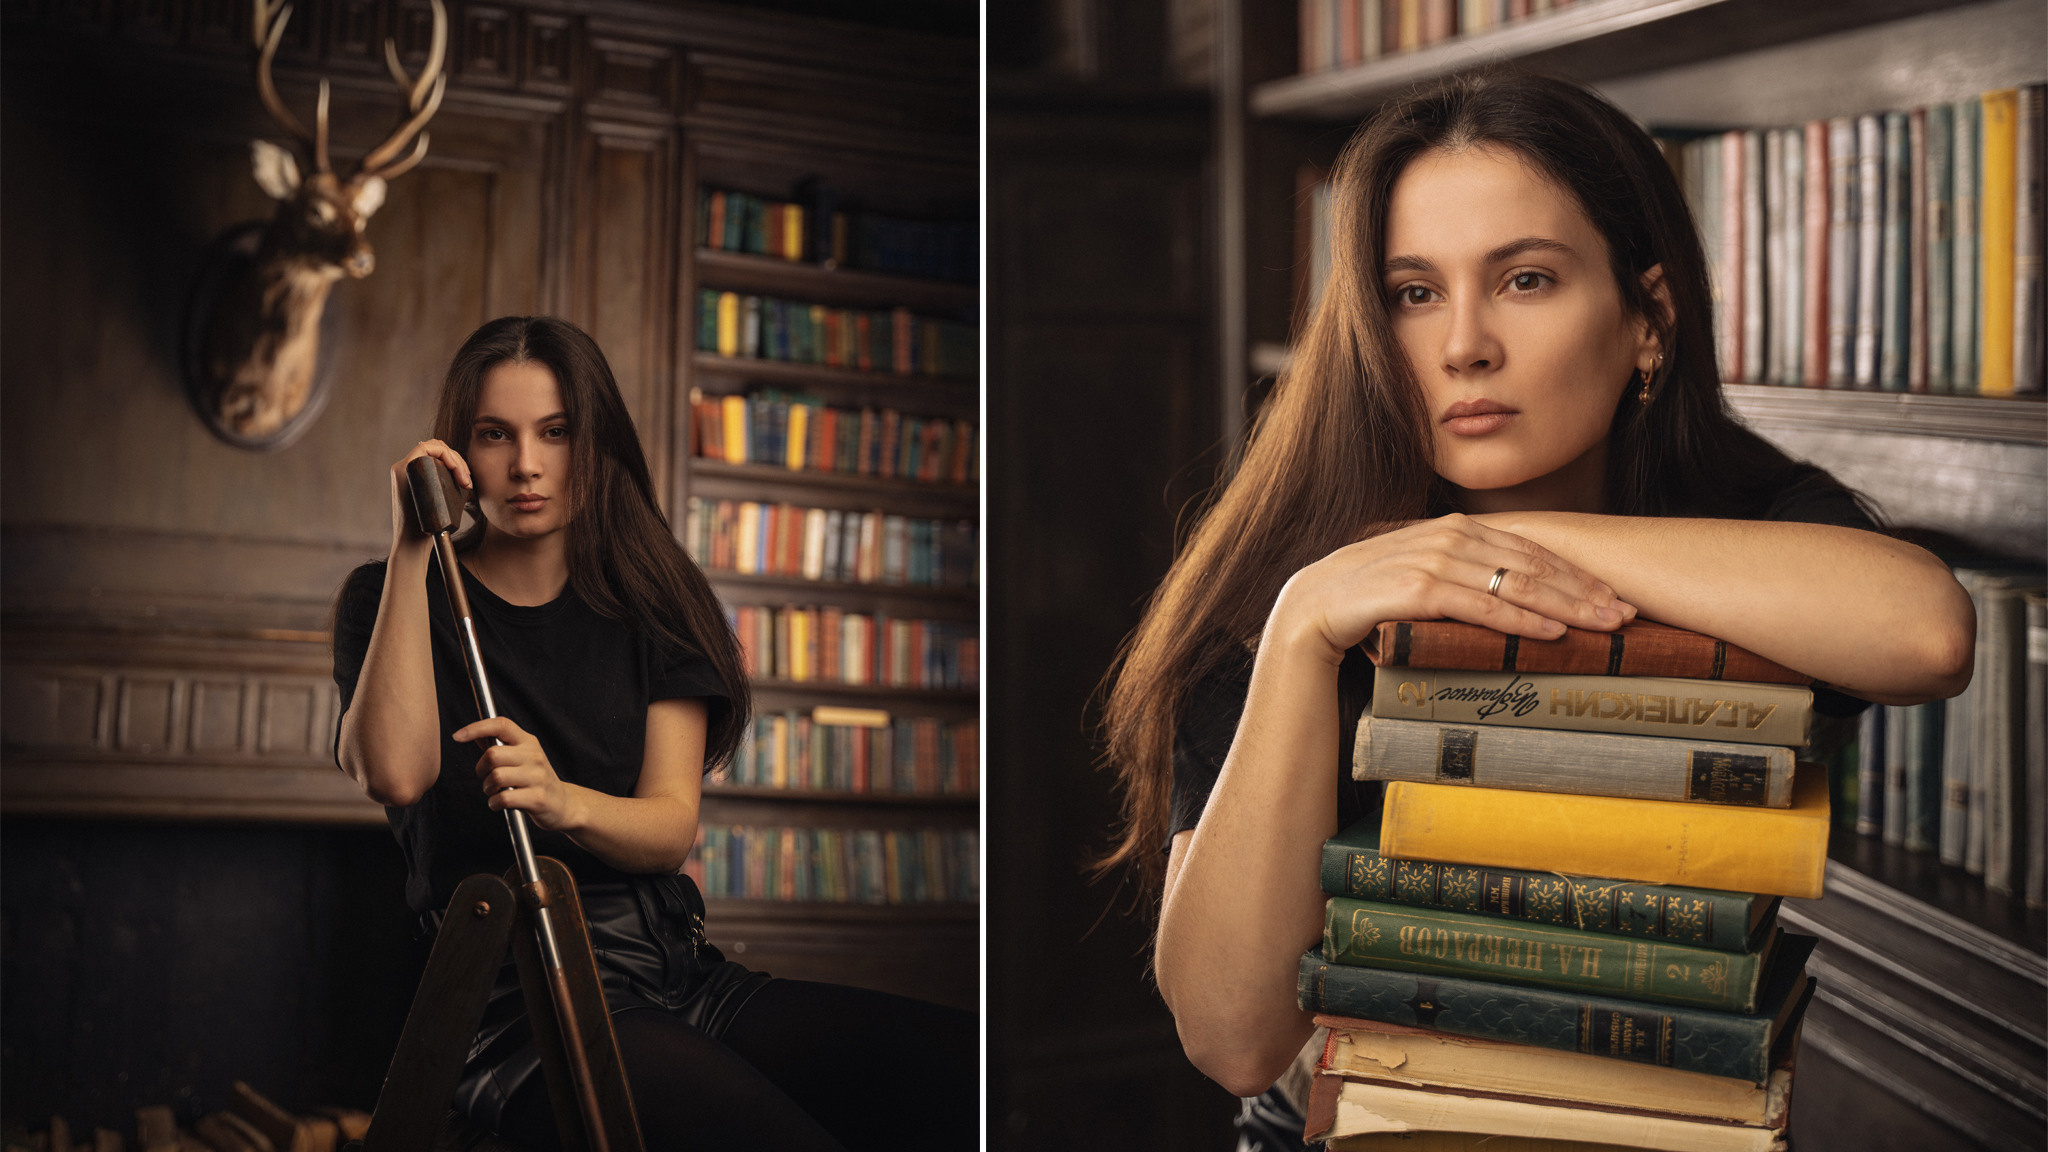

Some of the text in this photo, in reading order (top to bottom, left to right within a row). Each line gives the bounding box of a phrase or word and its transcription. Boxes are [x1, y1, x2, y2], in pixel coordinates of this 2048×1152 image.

[1398, 680, 1427, 707] 2
[1550, 690, 1777, 730] А.Г.АЛЕКСИН
[1400, 926, 1602, 977] Н.А. НЕКРАСОВ
[1665, 963, 1691, 982] 2
[1419, 1001, 1434, 1009] 1
